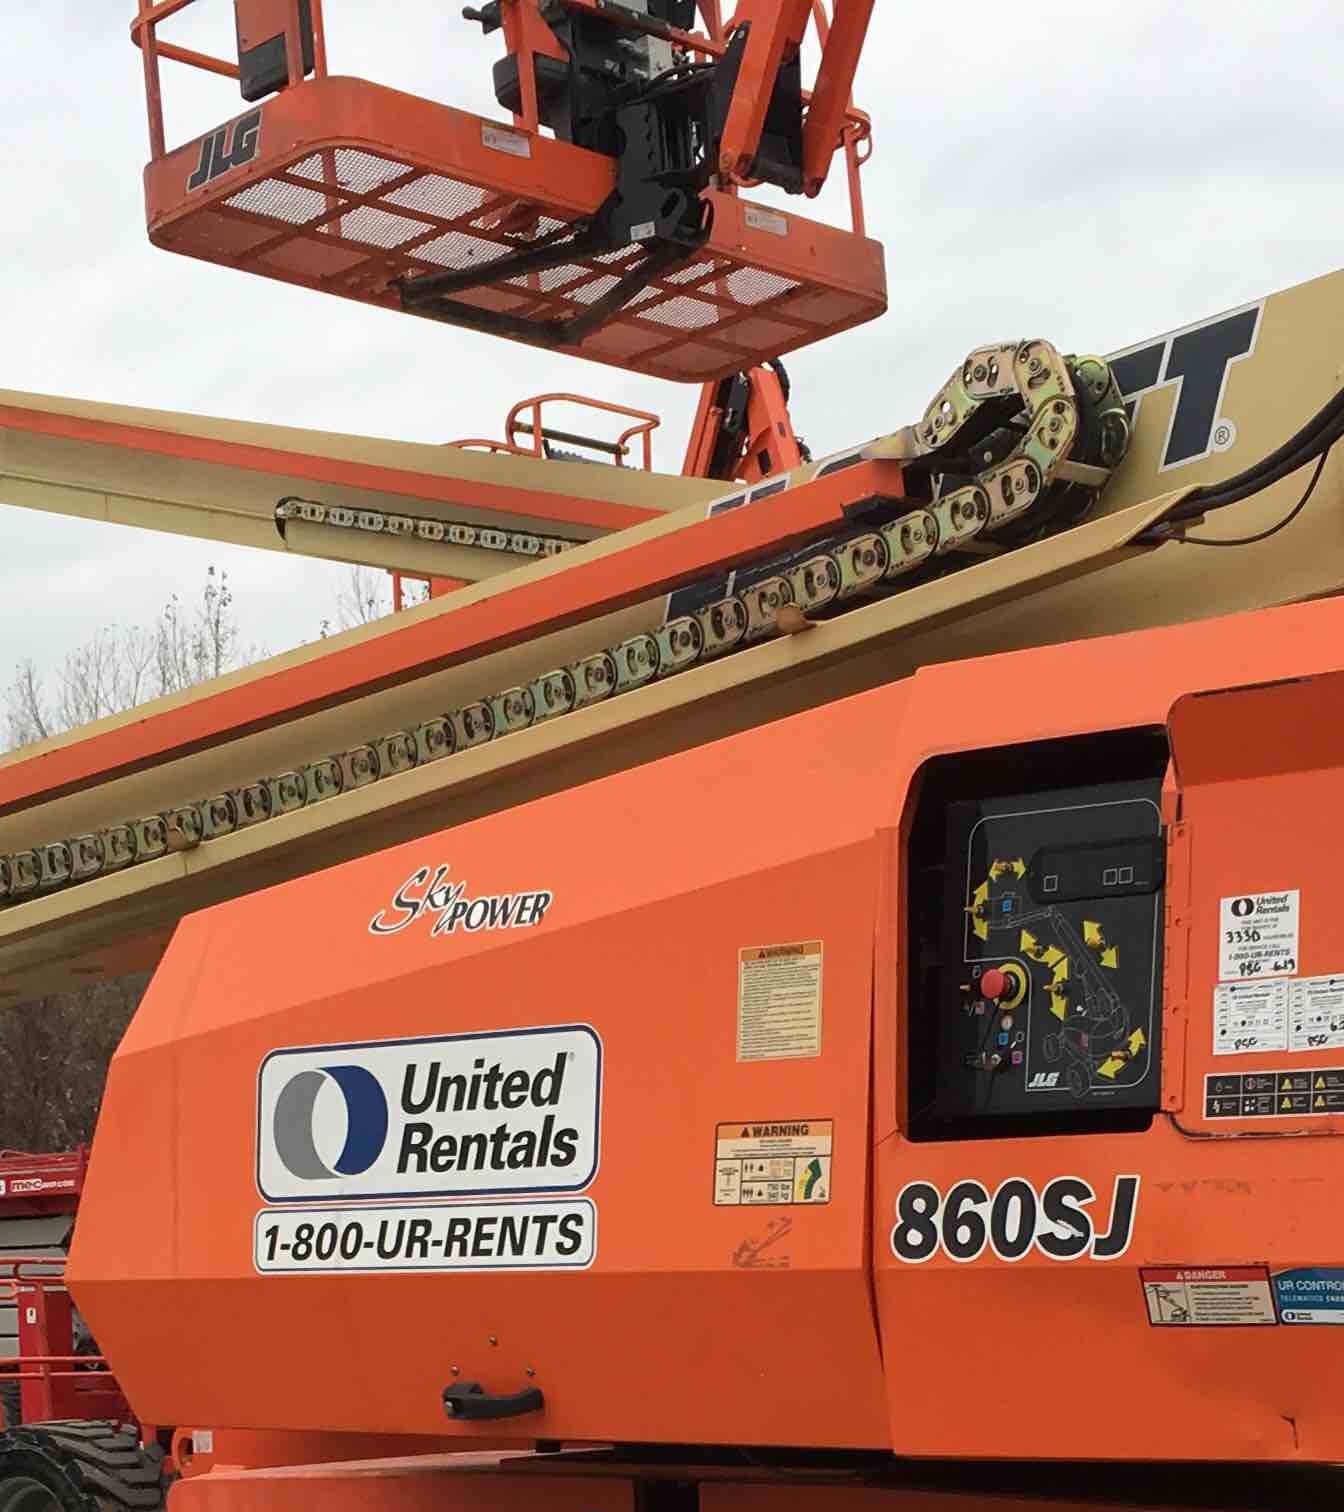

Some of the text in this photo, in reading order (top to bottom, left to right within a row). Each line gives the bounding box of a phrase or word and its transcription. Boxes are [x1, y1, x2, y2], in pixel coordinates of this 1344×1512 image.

[186, 107, 263, 192] JLG
[370, 865, 551, 935] Sky POWER
[401, 1052, 567, 1115] United
[1028, 1072, 1060, 1088] JLG
[396, 1114, 578, 1173] Rentals
[752, 1124, 809, 1137] WARNING
[264, 1213, 585, 1260] 1-800-UR-RENTS
[891, 1176, 1141, 1261] 860SJ
[1184, 1270, 1226, 1280] DANGER
